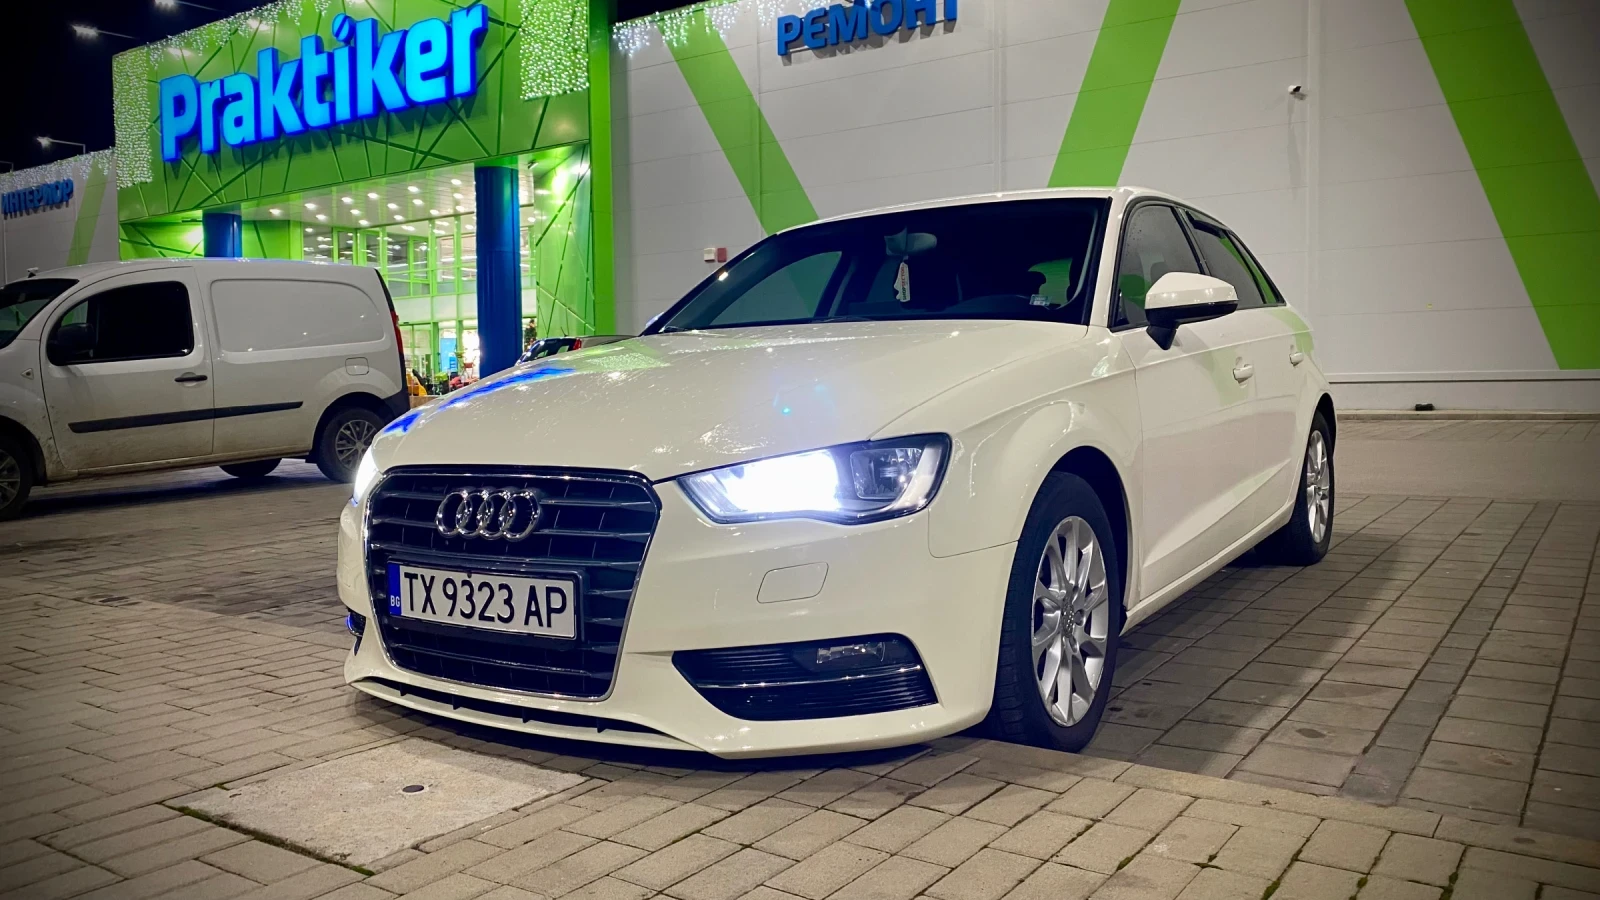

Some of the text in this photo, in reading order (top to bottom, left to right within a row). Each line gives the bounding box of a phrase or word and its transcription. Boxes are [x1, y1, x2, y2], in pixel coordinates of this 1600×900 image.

[159, 4, 488, 162] Praktiker
[390, 595, 401, 607] BG
[404, 572, 567, 628] TX 9323 AP
